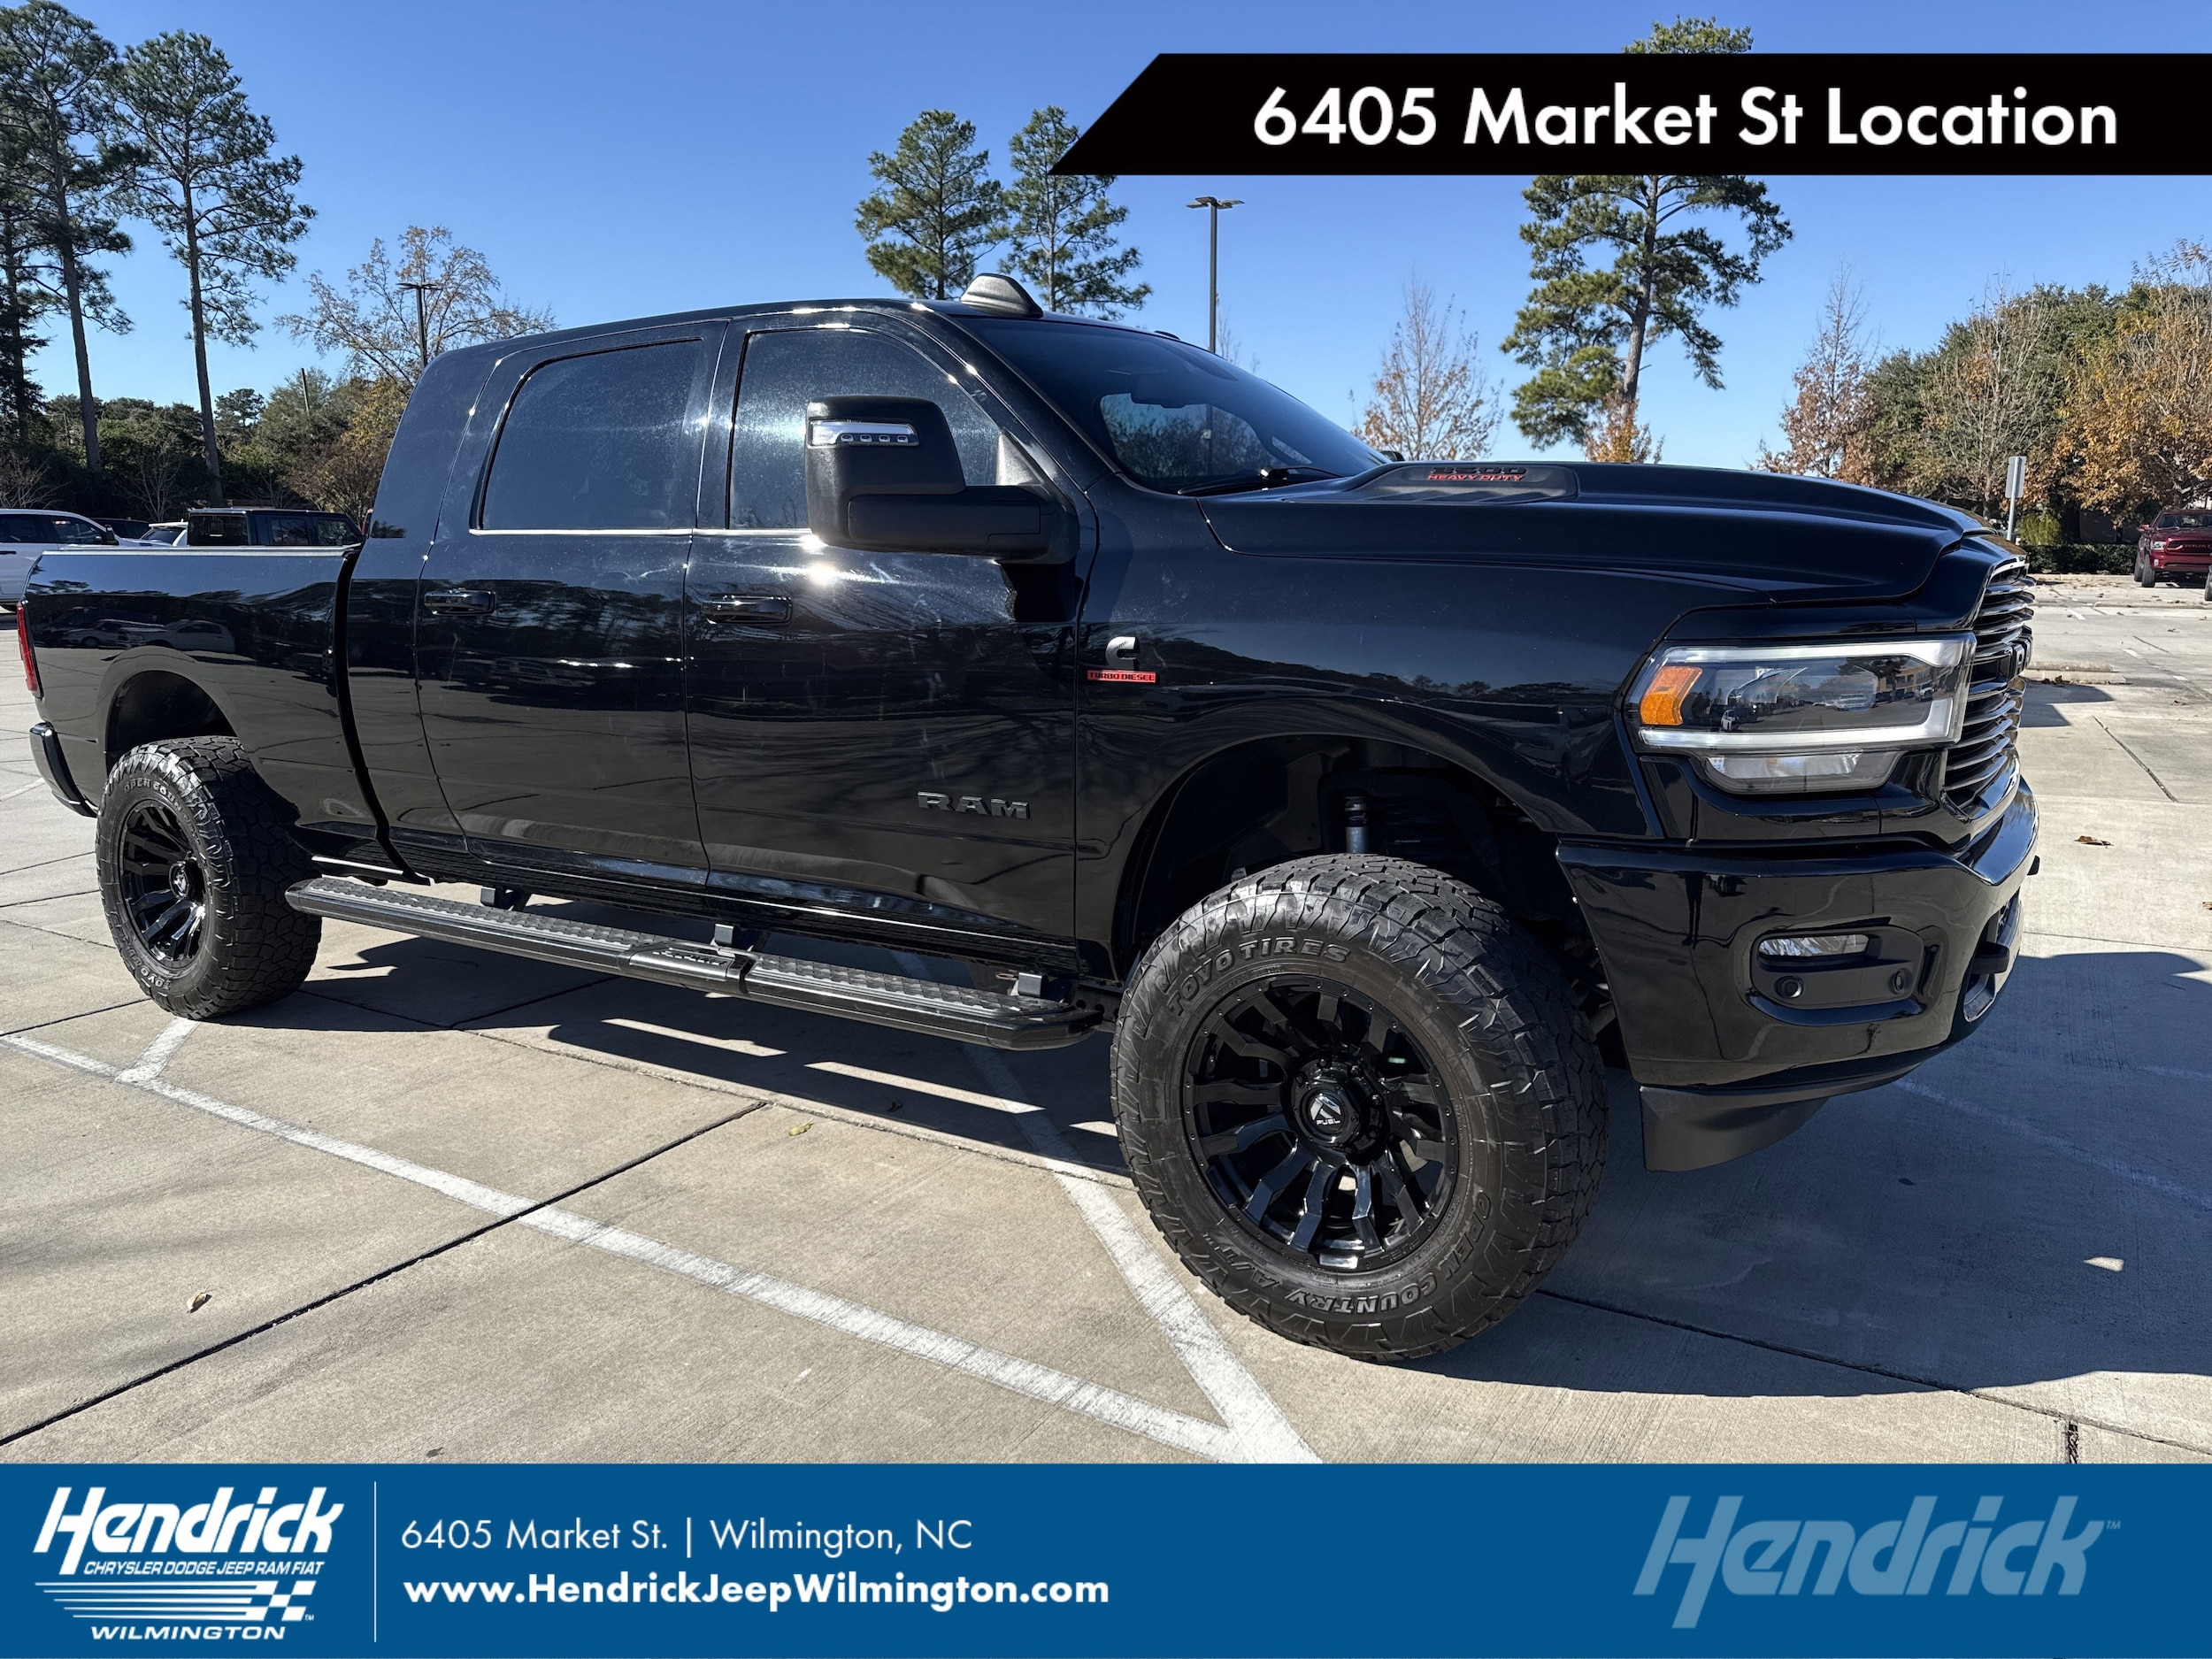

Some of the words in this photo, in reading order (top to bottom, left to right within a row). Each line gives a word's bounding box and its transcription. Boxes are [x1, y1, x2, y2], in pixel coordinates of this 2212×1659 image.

[1088, 672, 1120, 680] TURBO
[1121, 672, 1156, 682] DIESEL
[918, 791, 1031, 819] RAM
[1166, 949, 1236, 1017] TOYO
[1239, 936, 1351, 964] TIRES
[1437, 1189, 1492, 1281] OPEN
[1285, 1271, 1438, 1314] COUNTRY
